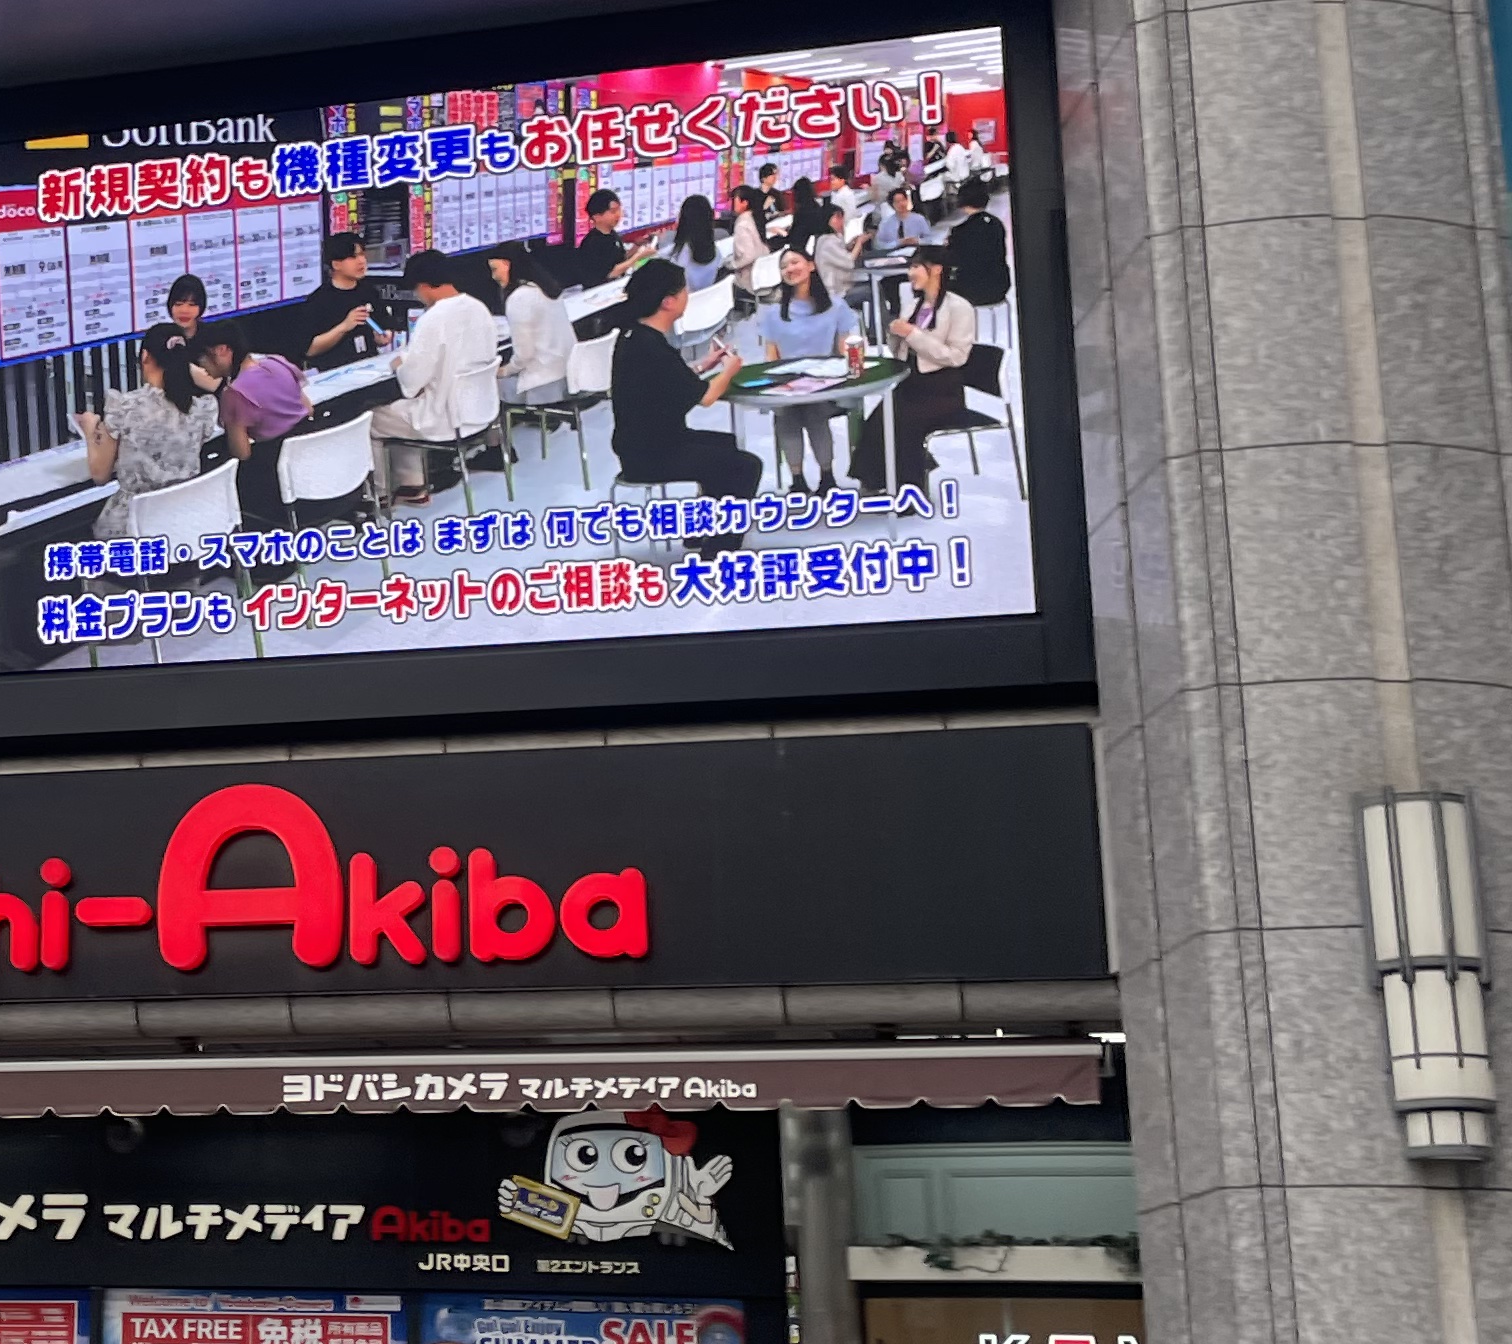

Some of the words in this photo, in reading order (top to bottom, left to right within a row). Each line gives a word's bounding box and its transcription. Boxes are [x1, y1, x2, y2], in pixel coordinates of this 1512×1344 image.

[282, 1072, 509, 1102] ヨドバシカメラ
[518, 1076, 682, 1100] マルチメディア
[683, 1076, 757, 1099] Akiba
[103, 1202, 366, 1241] マルチメディア
[370, 1205, 491, 1243] Akiba
[417, 1252, 511, 1273] JR中央口
[130, 1318, 176, 1339] TAX
[183, 1318, 243, 1340] FREE
